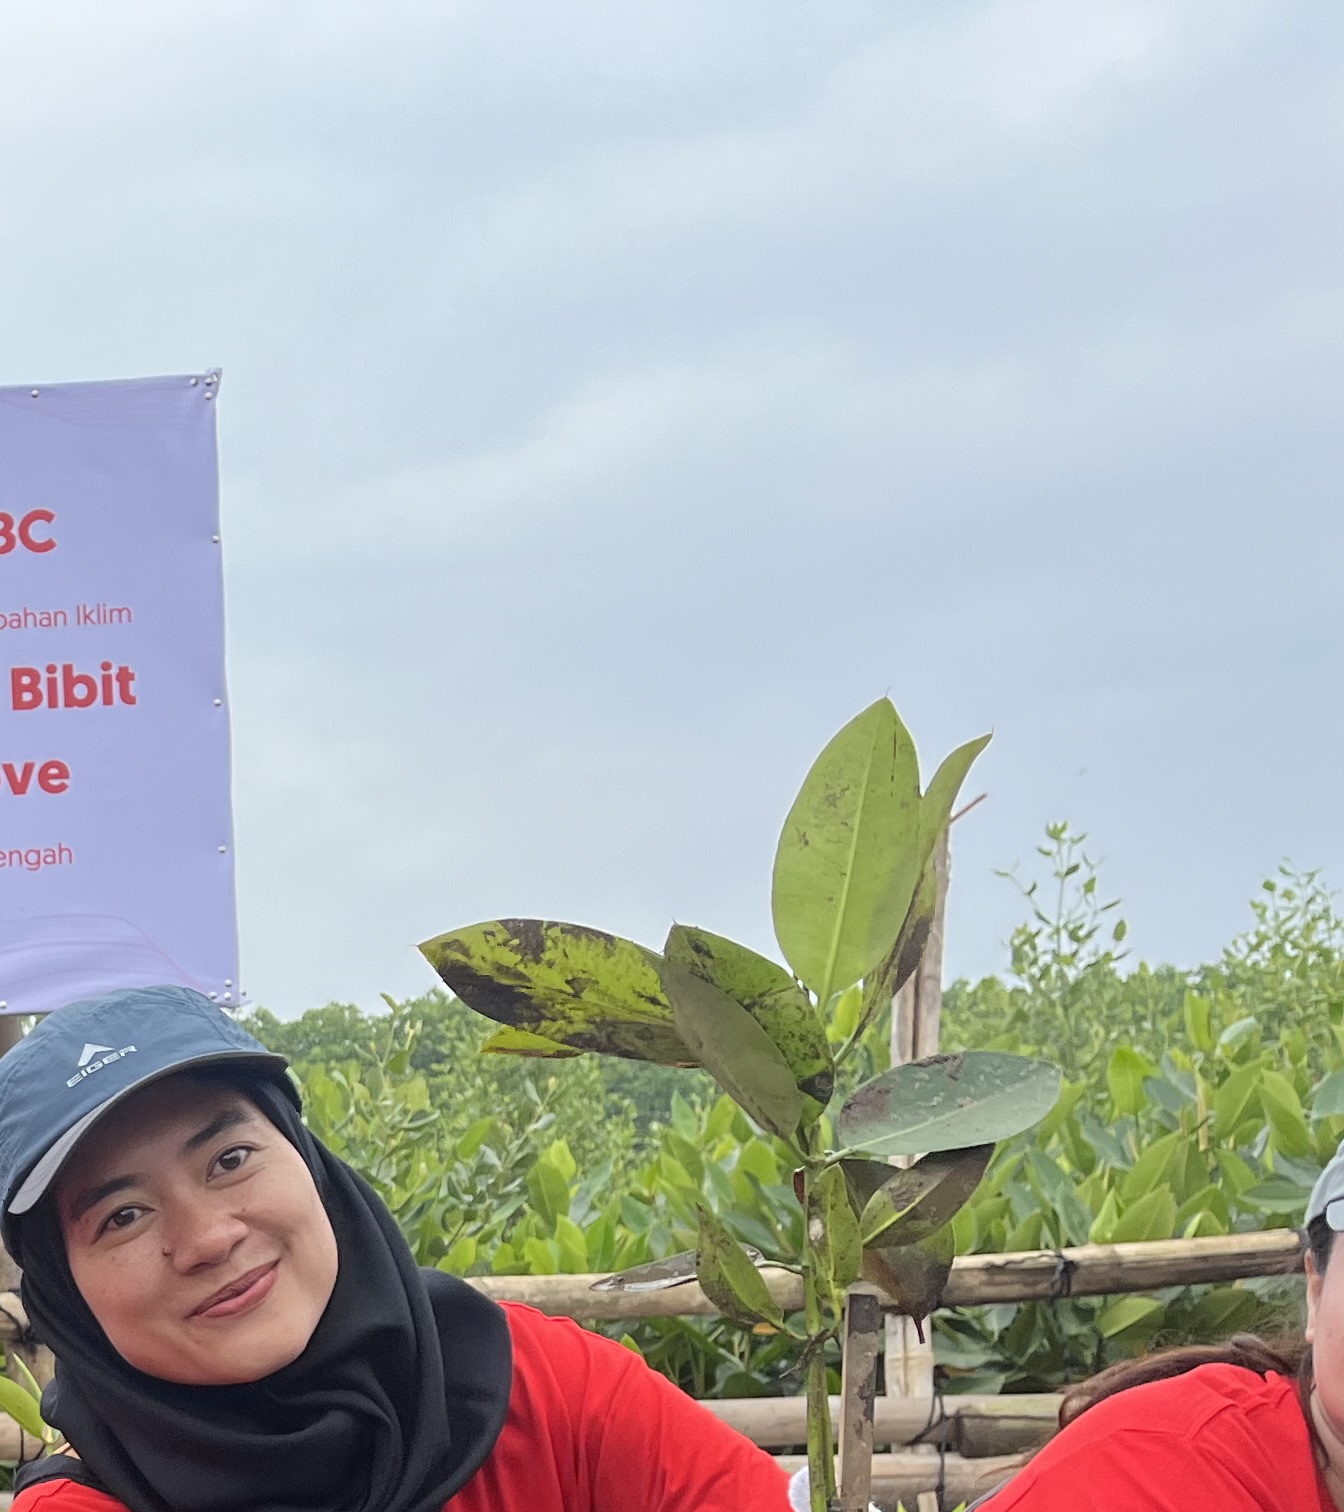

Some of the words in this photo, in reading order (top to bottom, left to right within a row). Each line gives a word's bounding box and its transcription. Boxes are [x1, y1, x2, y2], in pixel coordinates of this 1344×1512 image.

[76, 602, 133, 627] Iklim
[9, 659, 139, 714] Bibit
[66, 1045, 138, 1088] EIGER
